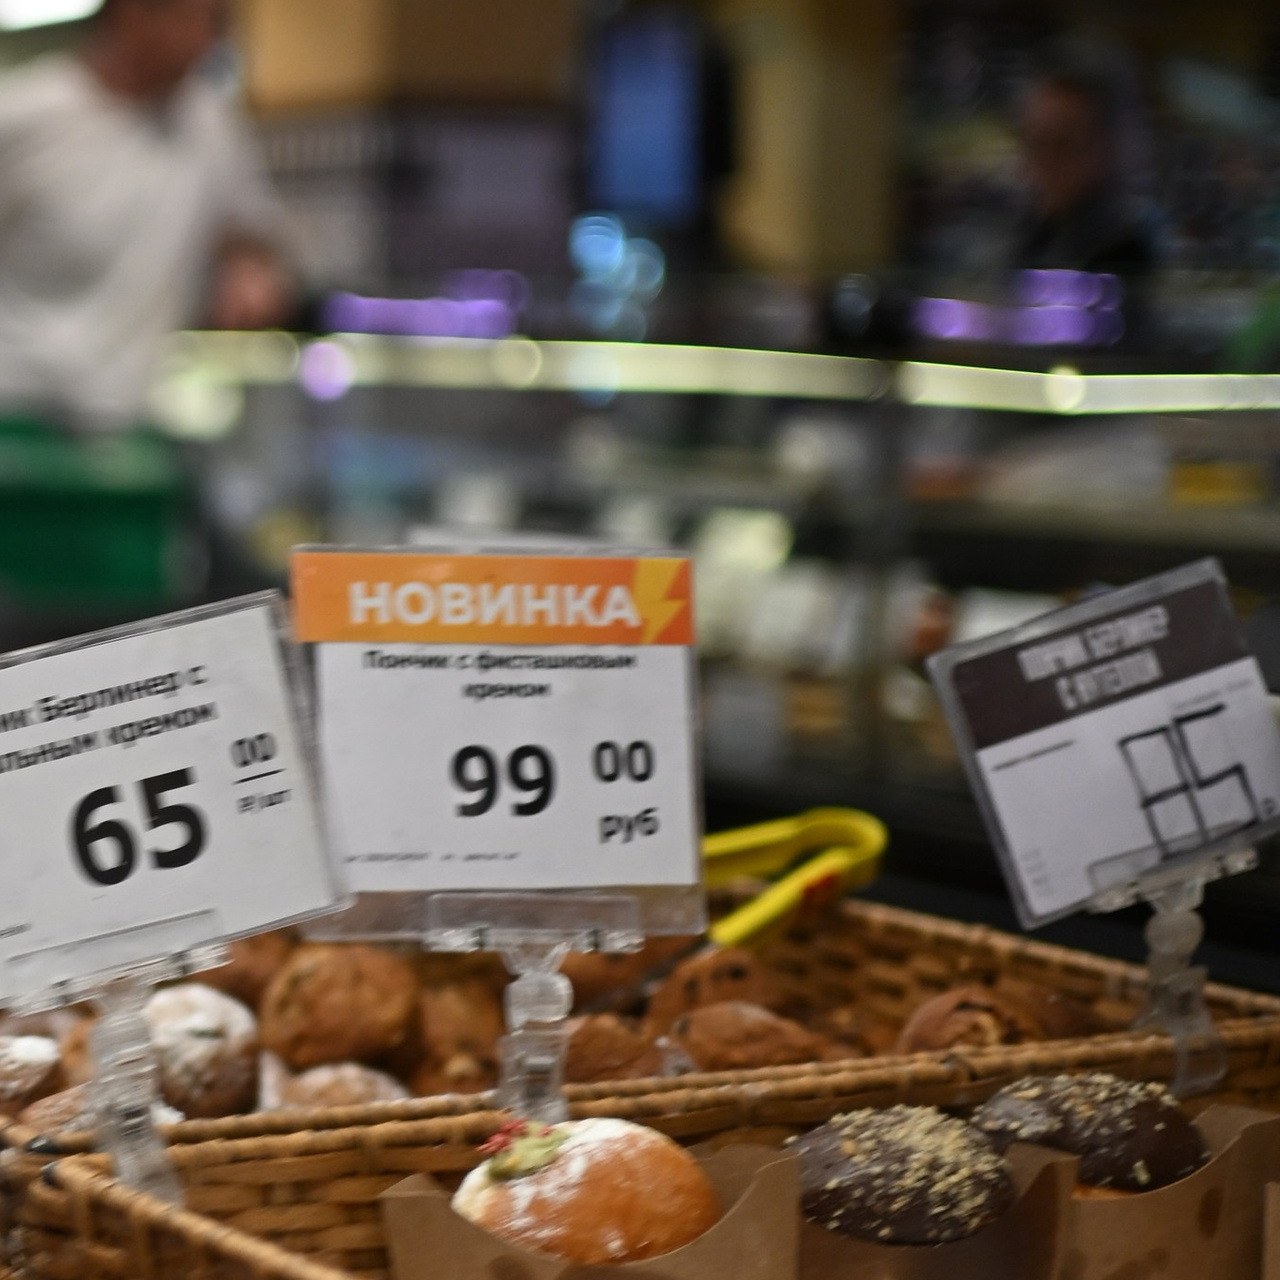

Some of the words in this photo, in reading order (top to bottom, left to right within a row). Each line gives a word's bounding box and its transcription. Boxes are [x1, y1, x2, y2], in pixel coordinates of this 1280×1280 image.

[349, 581, 642, 626] НОВИНКА
[365, 651, 450, 669] Пончик
[457, 655, 474, 669] с
[476, 649, 637, 673] фисташковым
[37, 672, 182, 723] Берлинер
[184, 666, 207, 686] с
[463, 684, 550, 700] кремом
[106, 703, 217, 748] кремом
[231, 733, 276, 768] 00
[451, 745, 555, 817] 99
[593, 741, 654, 783] 00
[72, 768, 206, 886] 65
[601, 808, 658, 842] руб
